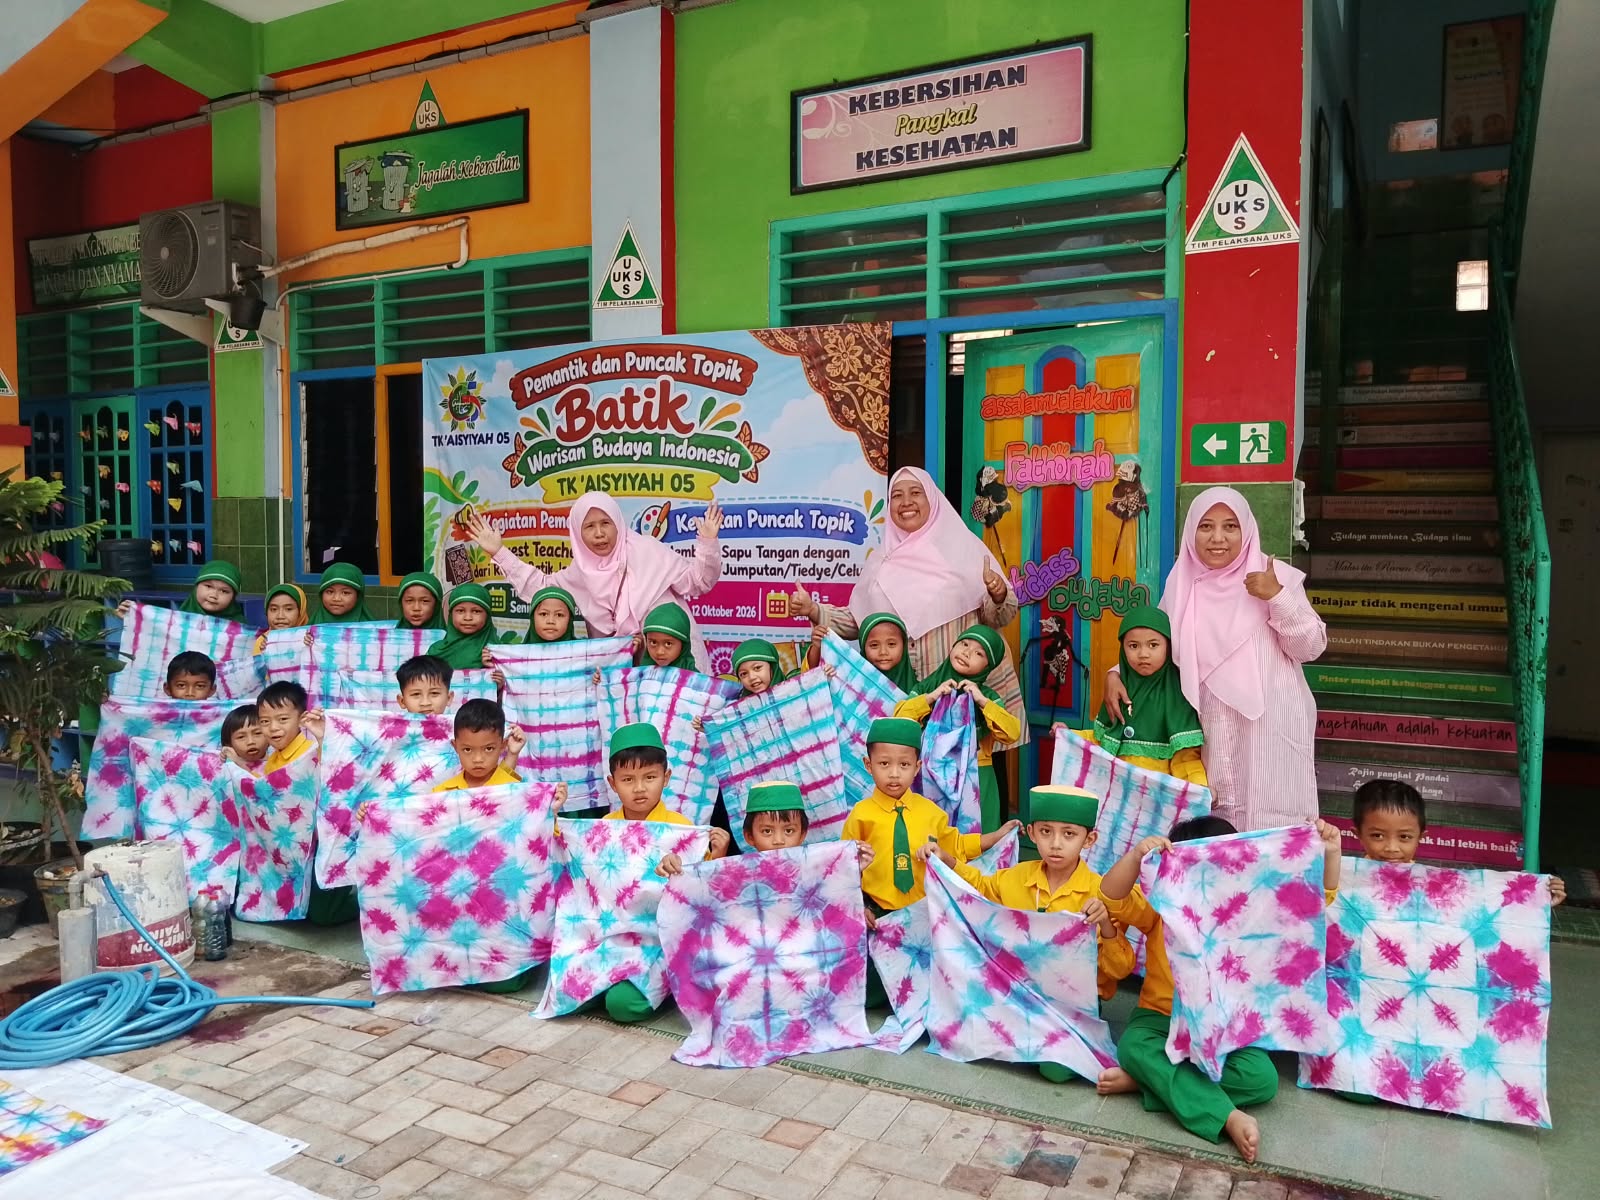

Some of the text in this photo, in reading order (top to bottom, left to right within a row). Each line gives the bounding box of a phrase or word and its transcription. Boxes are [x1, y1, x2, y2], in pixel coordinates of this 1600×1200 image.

[849, 65, 1026, 115] KEBERSIHAN
[894, 102, 978, 136] Pangkal
[856, 127, 1017, 172] KESEHATAN
[415, 151, 520, 190] Jagalah Kebersihan
[1217, 198, 1265, 215] UKS
[1212, 235, 1270, 247] PELAKSANA
[1272, 232, 1292, 240] UKS
[103, 260, 142, 287] NYAMA
[613, 270, 642, 282] UKS
[523, 350, 743, 399] Pemantik dan Puncak Topik
[554, 379, 695, 443] Batik
[982, 385, 1132, 419] assalamualaikum
[496, 432, 510, 444] 05
[527, 435, 741, 475] Warisan Budaya Indonesia
[1005, 440, 1112, 485] Fathonah
[556, 476, 578, 496] TK
[670, 473, 695, 493] 05
[482, 511, 537, 535] Kegiatan
[747, 508, 804, 529] Puncak
[809, 509, 855, 535] Topik
[721, 544, 850, 562] Sapu Tangan dengan
[473, 563, 491, 577] dari
[691, 604, 757, 618] 12 Oktober 2026
[1312, 596, 1506, 614] Belajar tidak mengenal umur
[1363, 638, 1411, 647] TINDAKAN
[1412, 640, 1446, 649] BUKAN
[1317, 716, 1389, 735] ngetahuan
[1395, 721, 1440, 737] adalah
[1348, 767, 1450, 783] Rajin pangkal Pandai
[1436, 836, 1456, 847] hal
[1457, 839, 1488, 850] lebih
[1490, 842, 1518, 854] baik
